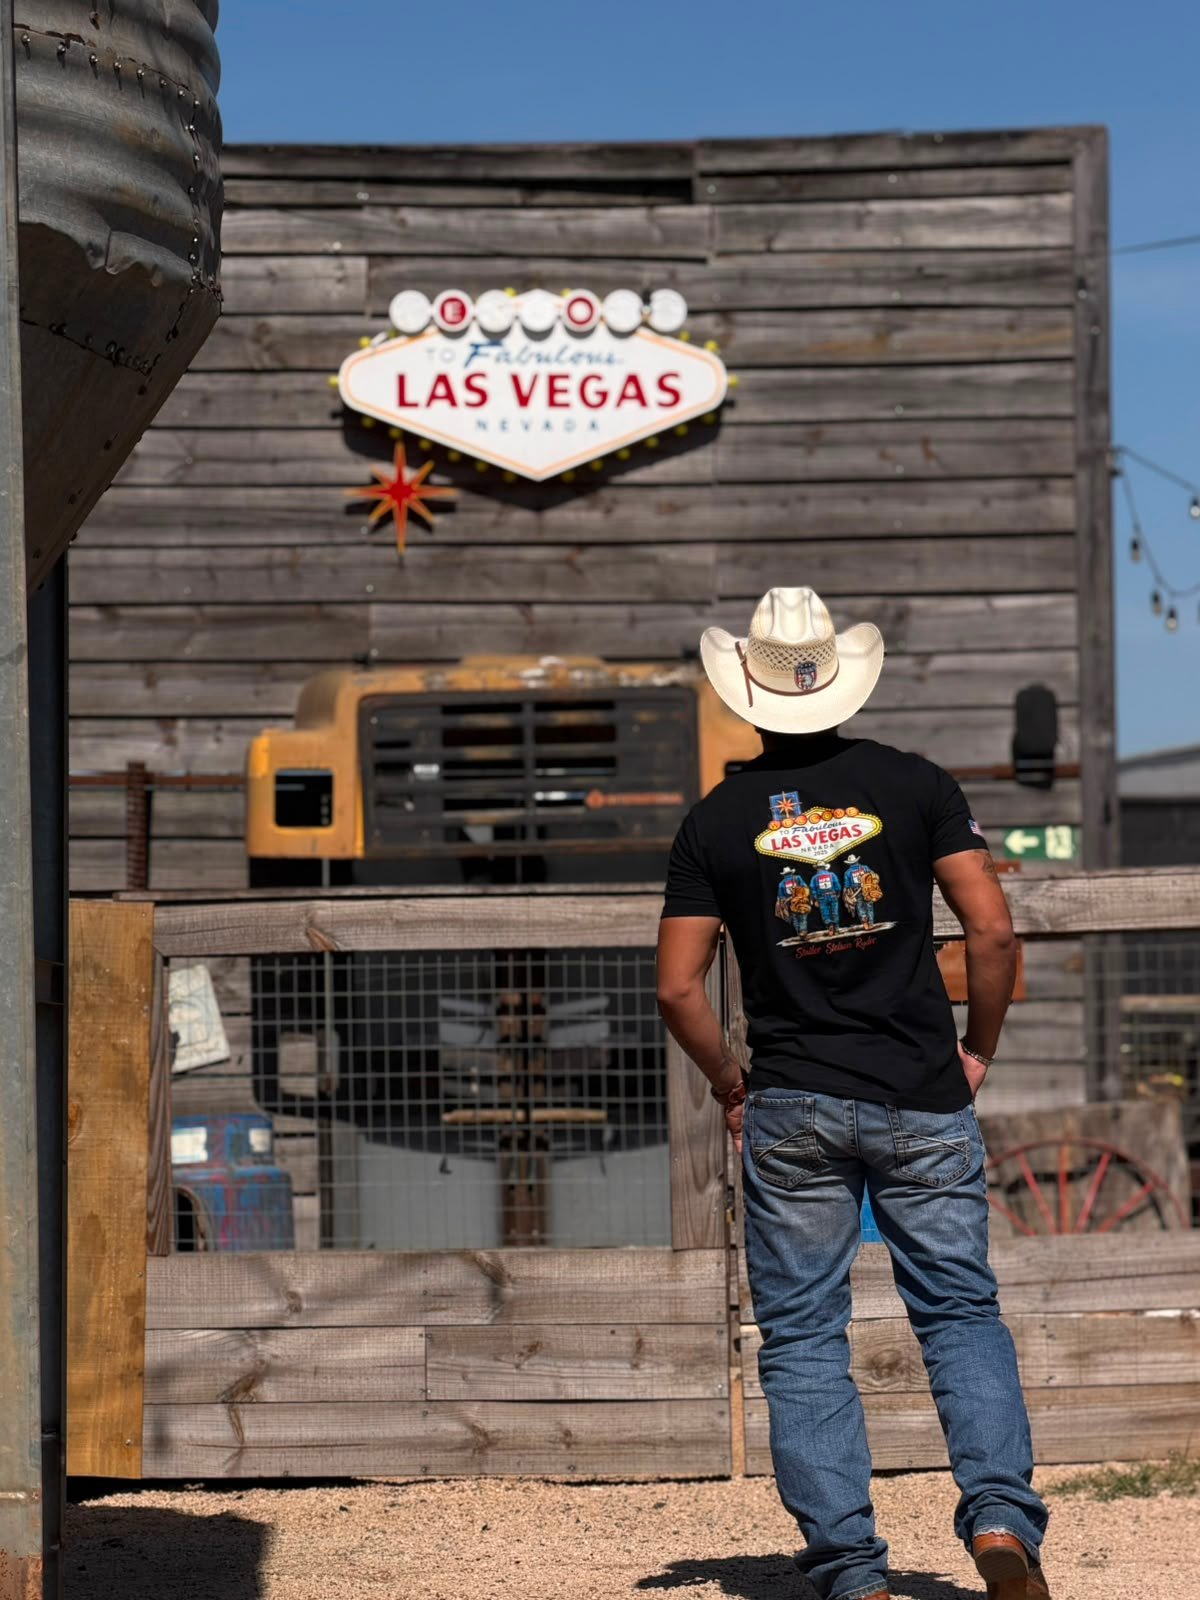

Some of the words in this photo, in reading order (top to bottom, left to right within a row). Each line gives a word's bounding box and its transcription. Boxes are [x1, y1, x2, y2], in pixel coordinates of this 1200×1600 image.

[397, 372, 489, 409] LAS
[510, 371, 682, 410] VEGAS
[475, 418, 600, 433] NEVADA
[770, 835, 802, 851] LAS
[805, 824, 863, 846] VEGAS
[780, 828, 791, 836] TO
[801, 843, 835, 853] NEVADA
